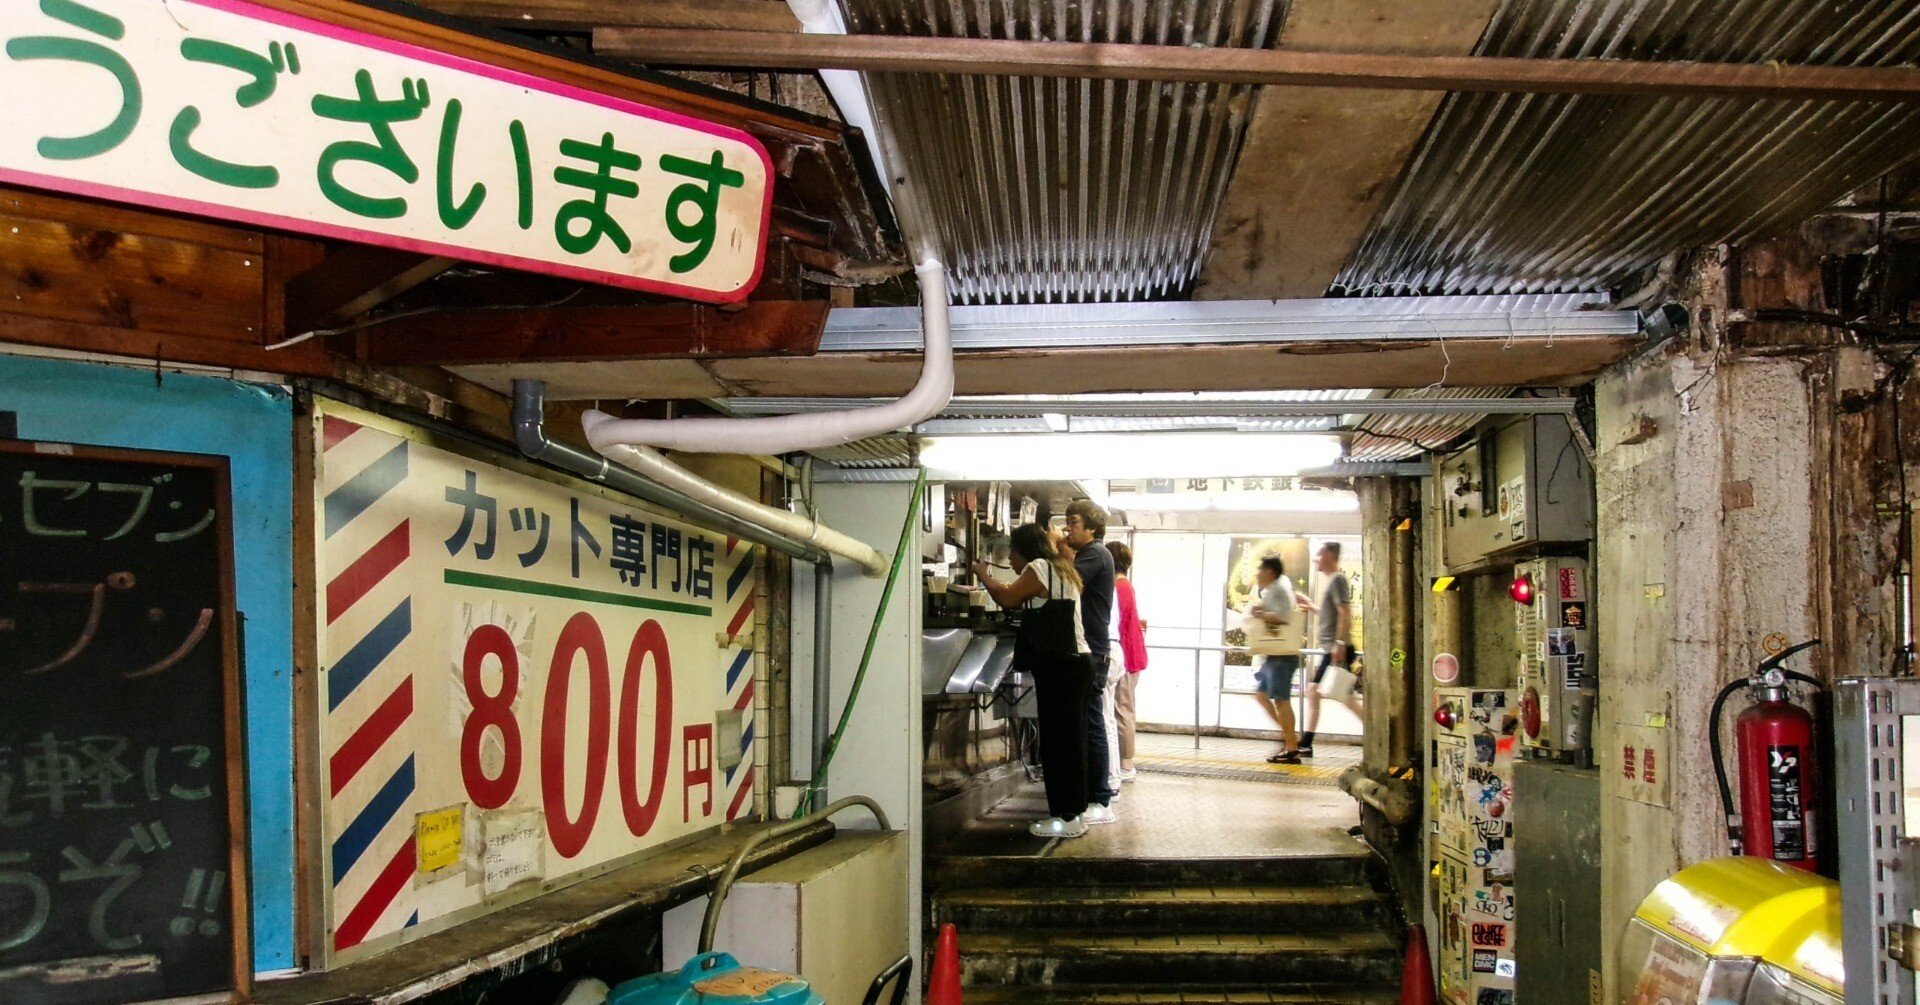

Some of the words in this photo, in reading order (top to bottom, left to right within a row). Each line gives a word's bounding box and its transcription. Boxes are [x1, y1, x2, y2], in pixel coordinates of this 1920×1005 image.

[5, 0, 746, 275] うございます
[444, 469, 715, 600] カット専門店
[460, 611, 713, 858] 800円
